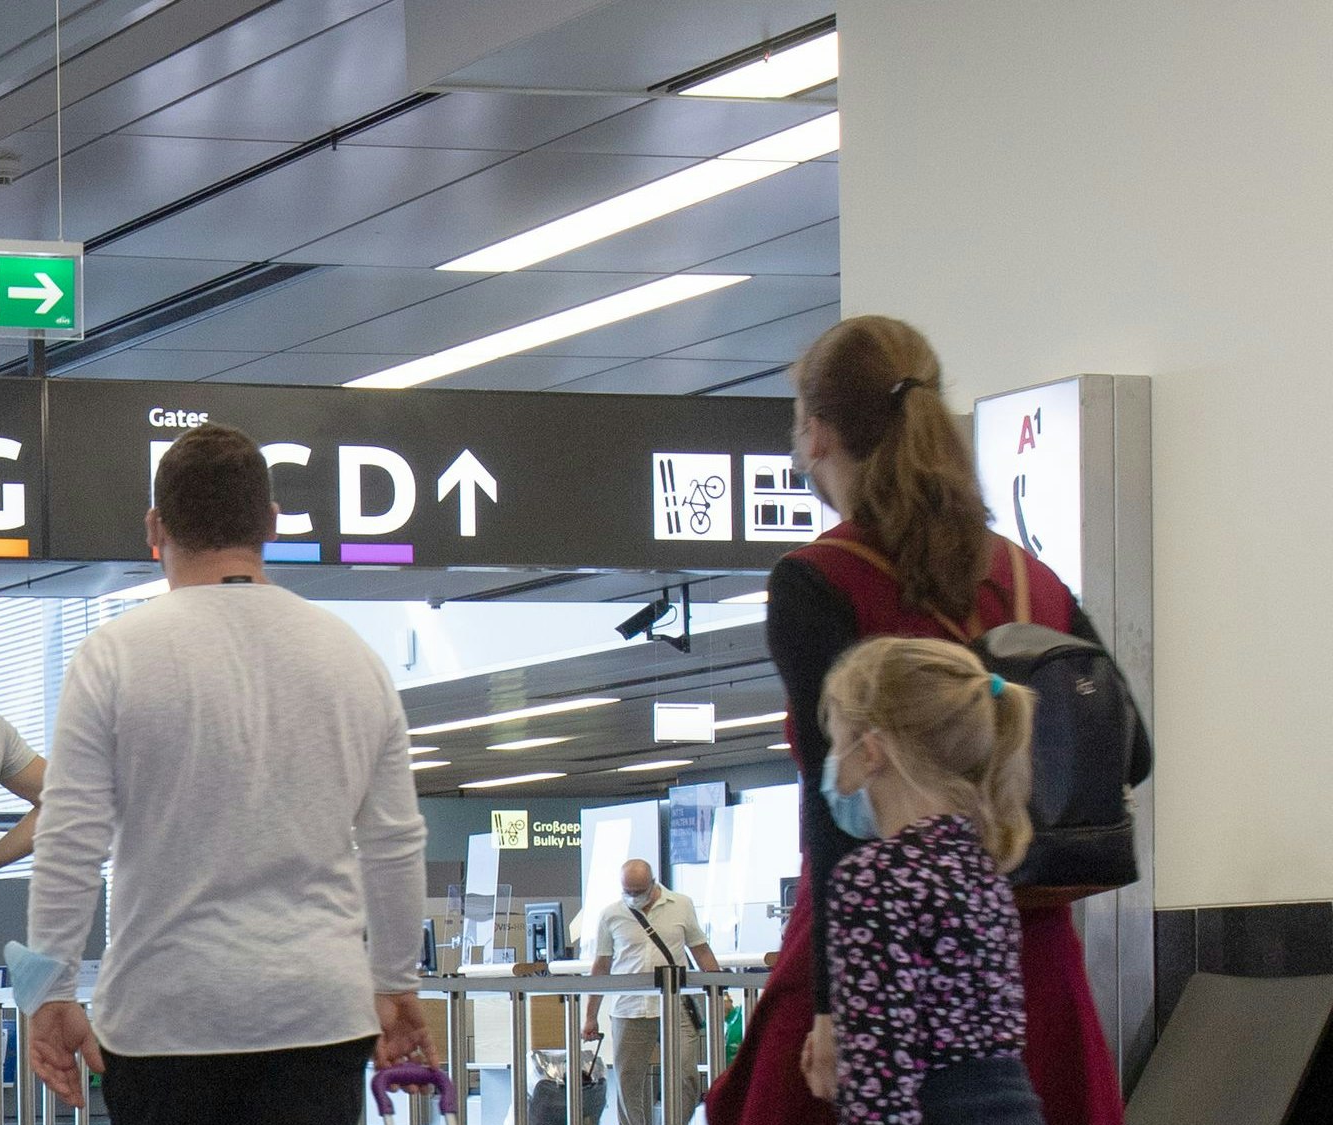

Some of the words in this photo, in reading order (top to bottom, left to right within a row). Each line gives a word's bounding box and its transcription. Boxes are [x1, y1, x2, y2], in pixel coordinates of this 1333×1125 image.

[148, 407, 209, 428] Gates
[338, 445, 416, 535] D
[533, 820, 581, 834] Großgep
[533, 835, 564, 848] Bulky
[566, 836, 581, 848] Lu
